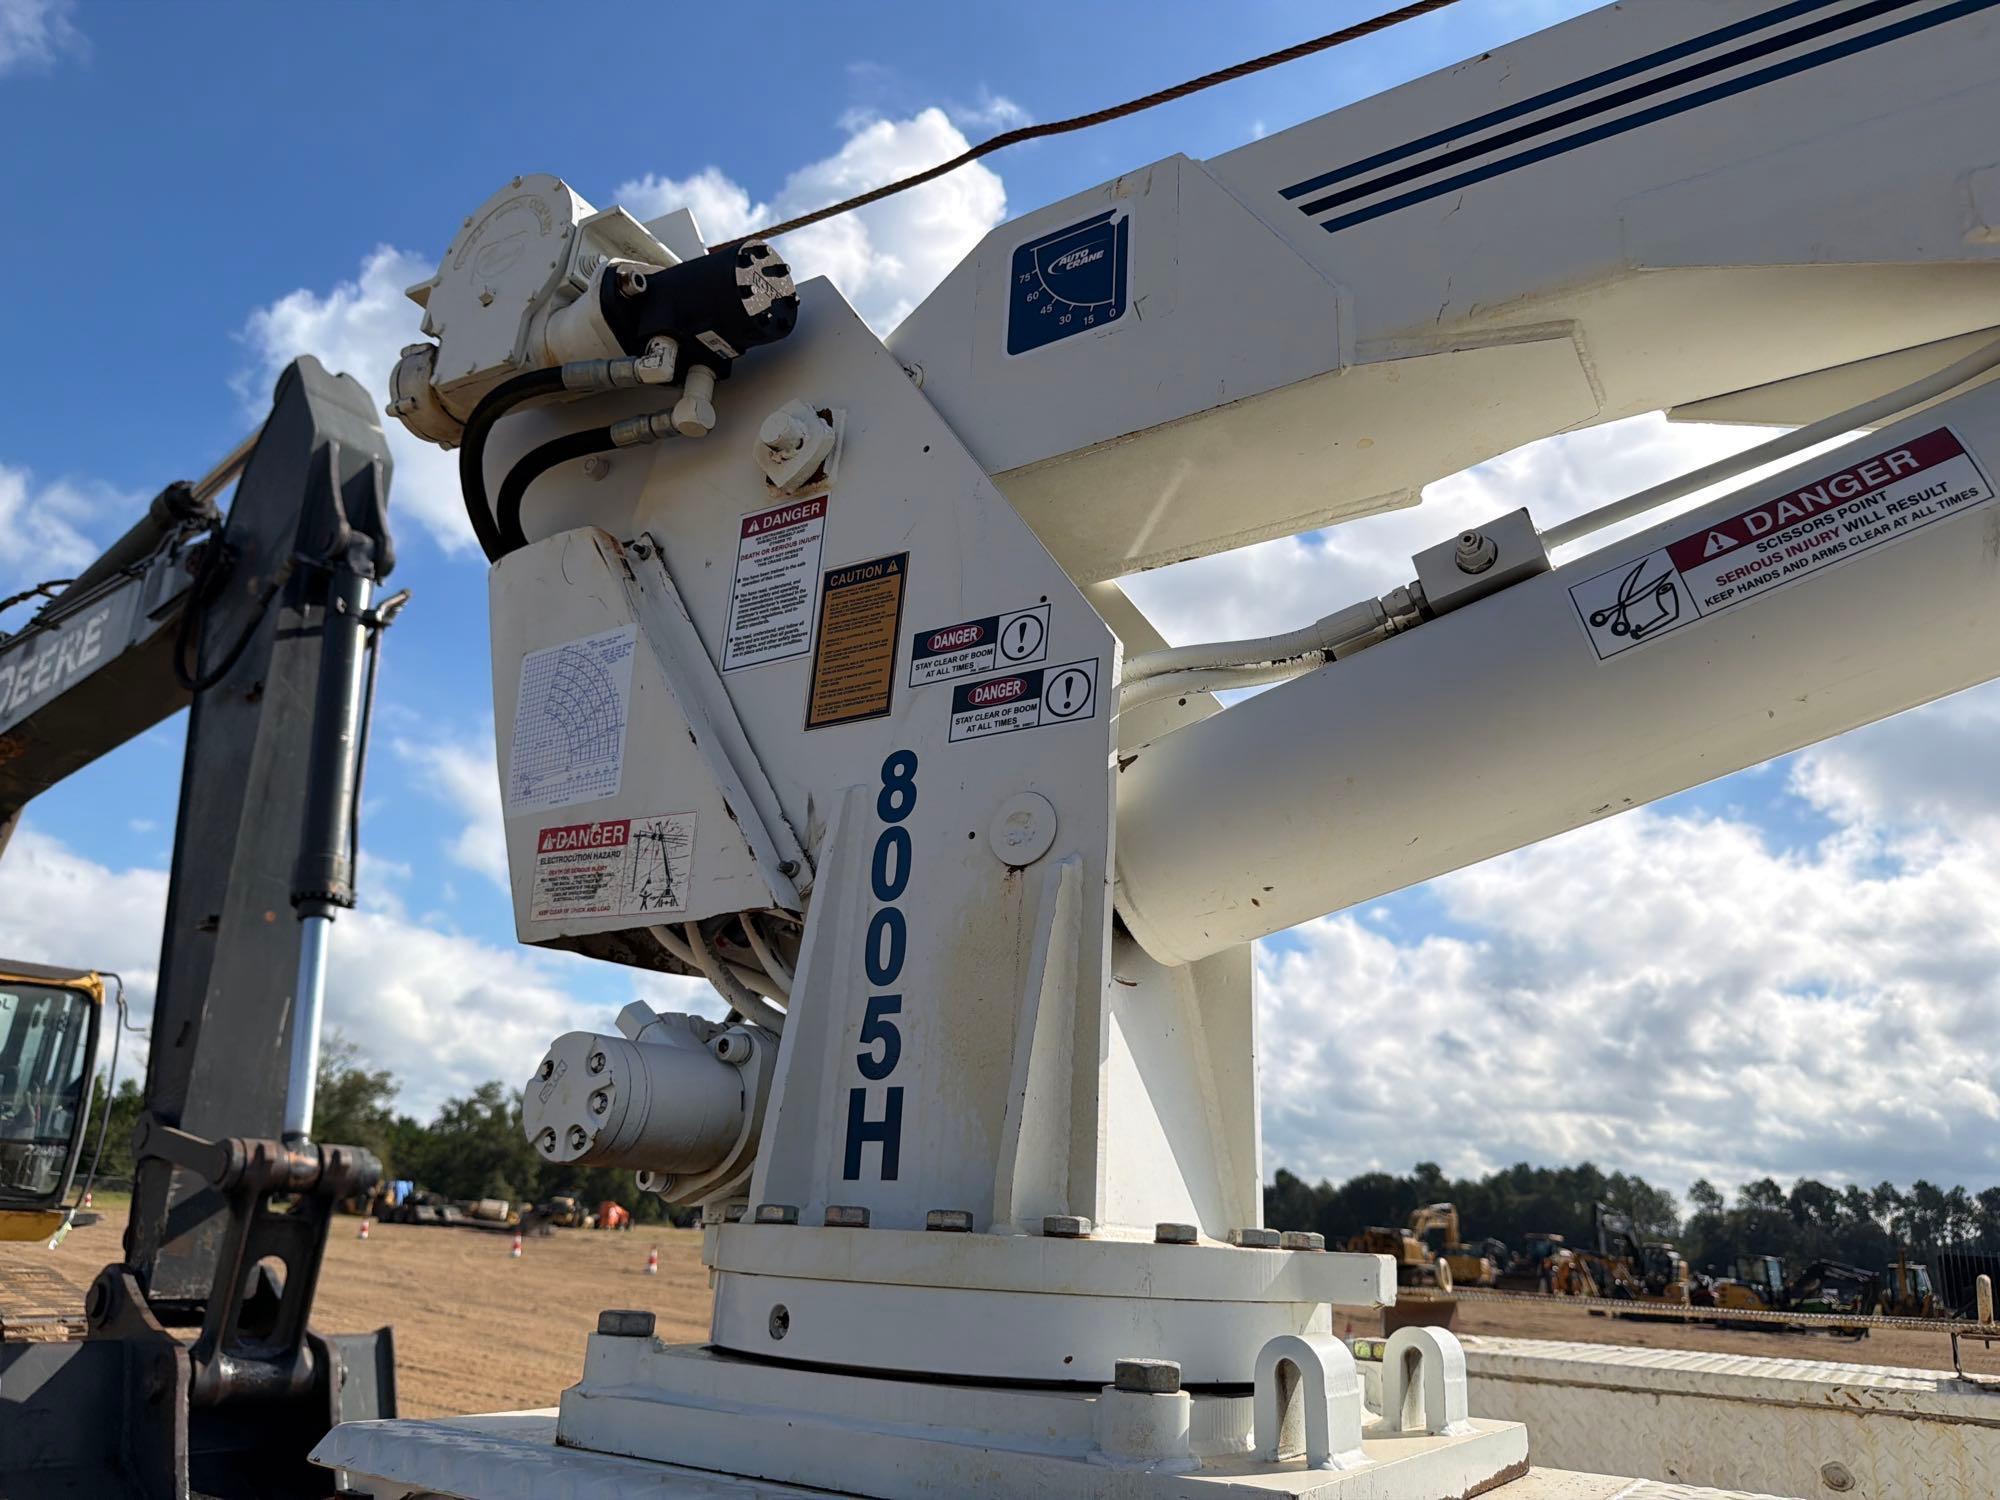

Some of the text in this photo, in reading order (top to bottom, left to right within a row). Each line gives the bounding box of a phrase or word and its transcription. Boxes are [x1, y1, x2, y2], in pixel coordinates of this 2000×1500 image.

[1059, 248, 1089, 266] AUTO
[1066, 250, 1104, 270] CRANE
[1019, 272, 1031, 284] 75
[1026, 291, 1039, 302] 60
[1040, 304, 1053, 315] 45
[1059, 314, 1072, 325] 30
[1083, 314, 1094, 326] 15
[1109, 308, 1116, 318] 0
[1743, 449, 1920, 536] DANGER
[763, 501, 821, 529] DANGER
[1756, 490, 1887, 553] SCISSORS POINT
[1716, 481, 1949, 587] SERIOUS INJURY WILL RESULT
[741, 551, 760, 561] DEATH
[770, 541, 797, 553] SERIOUS
[799, 534, 820, 545] INJURY
[1705, 487, 1979, 607] KEEP HANDS AND ARMS CLEAR AT ALL TIMES
[830, 564, 883, 587] CAUTION
[933, 627, 978, 649] DANGER
[0, 608, 110, 714] DEERE
[915, 648, 993, 671] STAY CLEAR OF BOOM
[926, 670, 934, 678] AT
[936, 667, 950, 676] ALL
[952, 662, 974, 673] TIMES
[975, 680, 1021, 703] DANGER
[956, 703, 1037, 725] STAY CLEAR OF BOOM
[966, 725, 975, 733] AT
[978, 722, 992, 731] ALL
[994, 717, 1018, 728] TIMES
[556, 824, 625, 849] DANGER
[540, 850, 621, 865] ELECTROCUTION HAZARD
[842, 749, 919, 1181] 8005H
